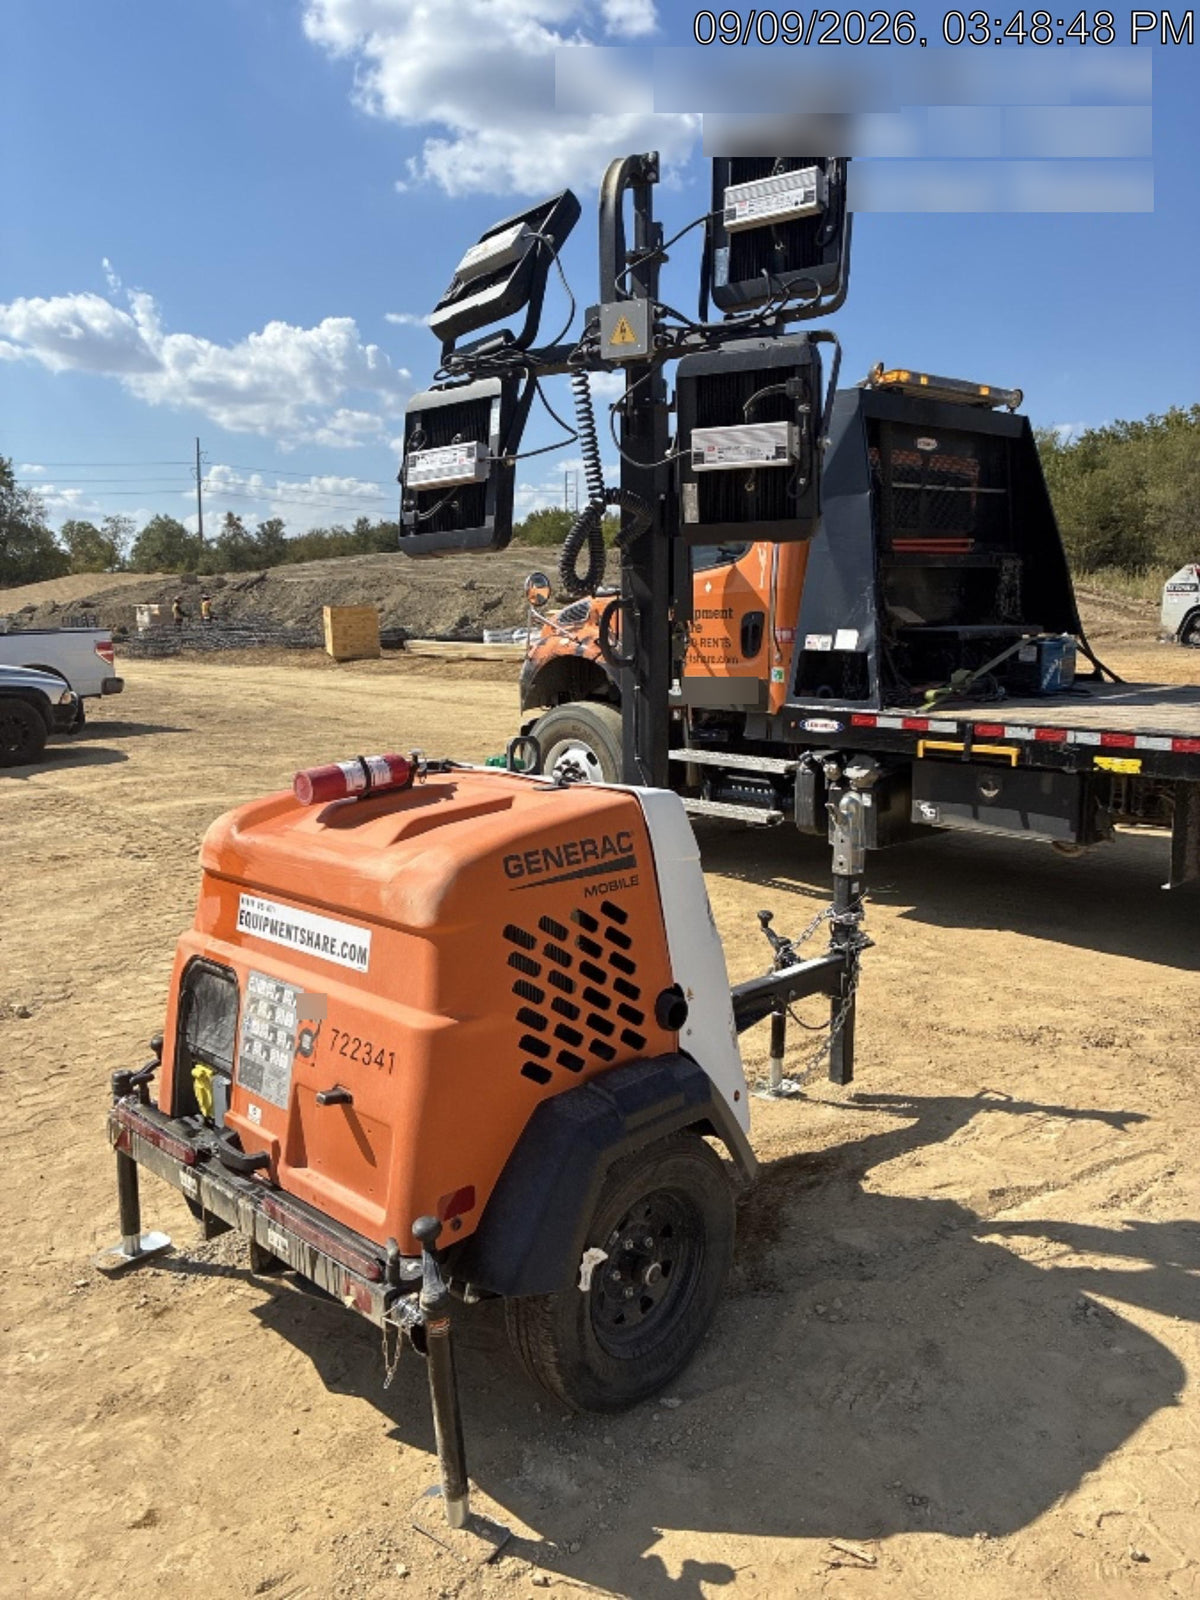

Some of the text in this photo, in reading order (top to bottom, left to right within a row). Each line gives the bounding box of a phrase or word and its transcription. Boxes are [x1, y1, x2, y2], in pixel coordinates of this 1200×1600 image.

[694, 607, 734, 621] pment
[503, 831, 634, 879] GENERAC
[584, 874, 639, 898] MOBILE
[239, 909, 368, 967] EQUIPMENTSHARE.COM
[330, 1028, 396, 1075] 722341
